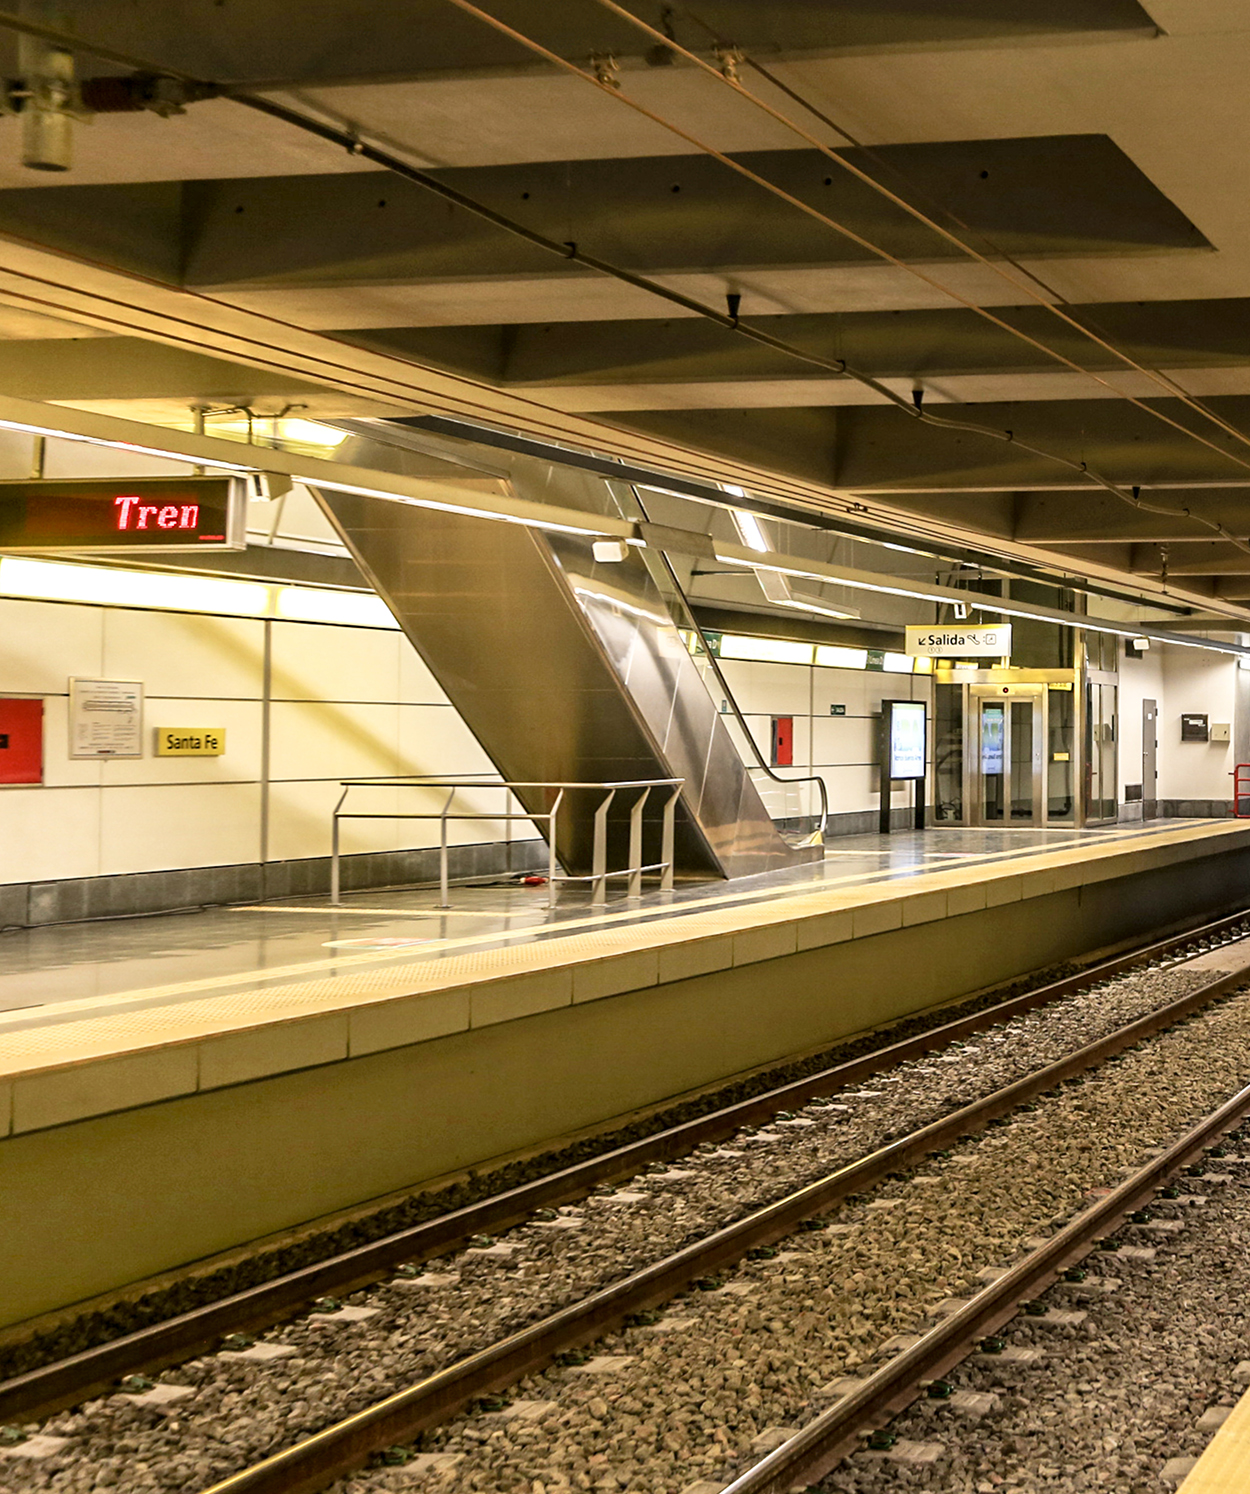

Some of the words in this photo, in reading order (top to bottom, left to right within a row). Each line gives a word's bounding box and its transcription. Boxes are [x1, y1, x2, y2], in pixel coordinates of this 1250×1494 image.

[114, 496, 199, 530] Tren
[928, 634, 965, 646] Salida
[166, 734, 201, 750] Santa
[204, 734, 218, 750] Fe
